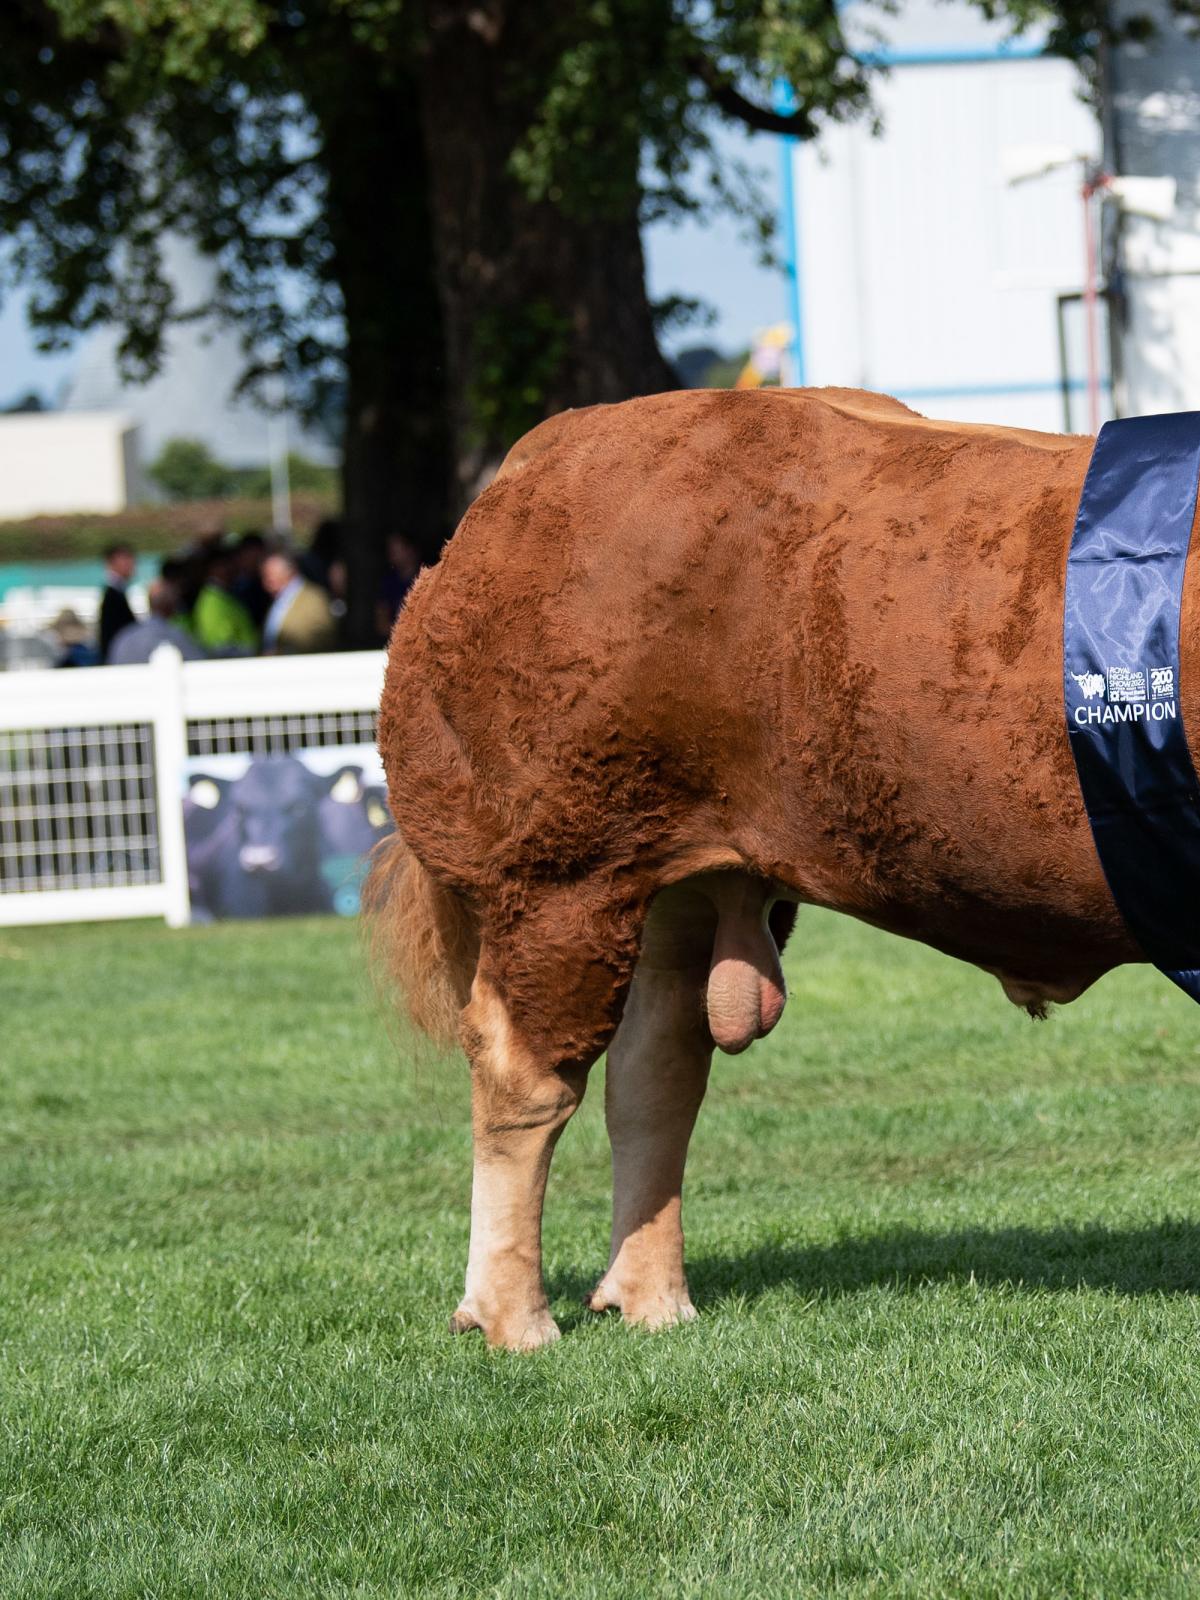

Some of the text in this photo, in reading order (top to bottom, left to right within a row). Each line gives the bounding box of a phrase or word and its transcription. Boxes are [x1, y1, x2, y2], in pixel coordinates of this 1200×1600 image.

[1110, 672, 1143, 681] HIGHLAND
[1151, 669, 1173, 686] 200
[1151, 684, 1173, 693] YEARS
[1075, 701, 1176, 724] CHAMPION
